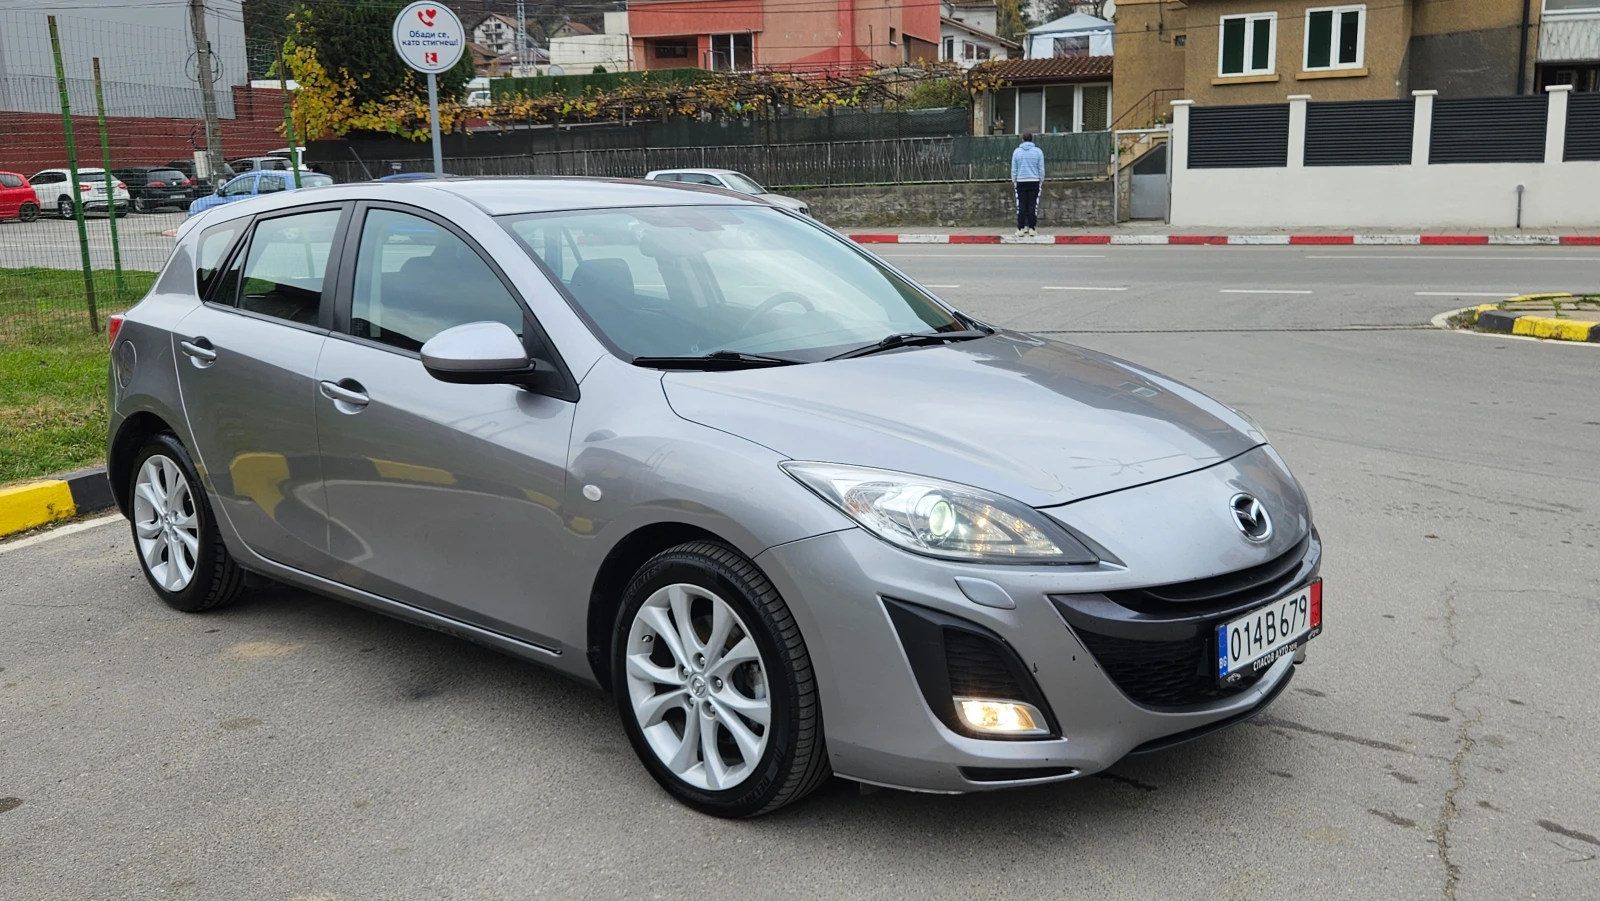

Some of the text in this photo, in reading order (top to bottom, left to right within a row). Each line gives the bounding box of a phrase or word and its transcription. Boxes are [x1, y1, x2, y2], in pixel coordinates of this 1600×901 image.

[409, 30, 436, 39] Обади
[1219, 656, 1227, 669] BG
[1253, 652, 1275, 672] СПАСОВ
